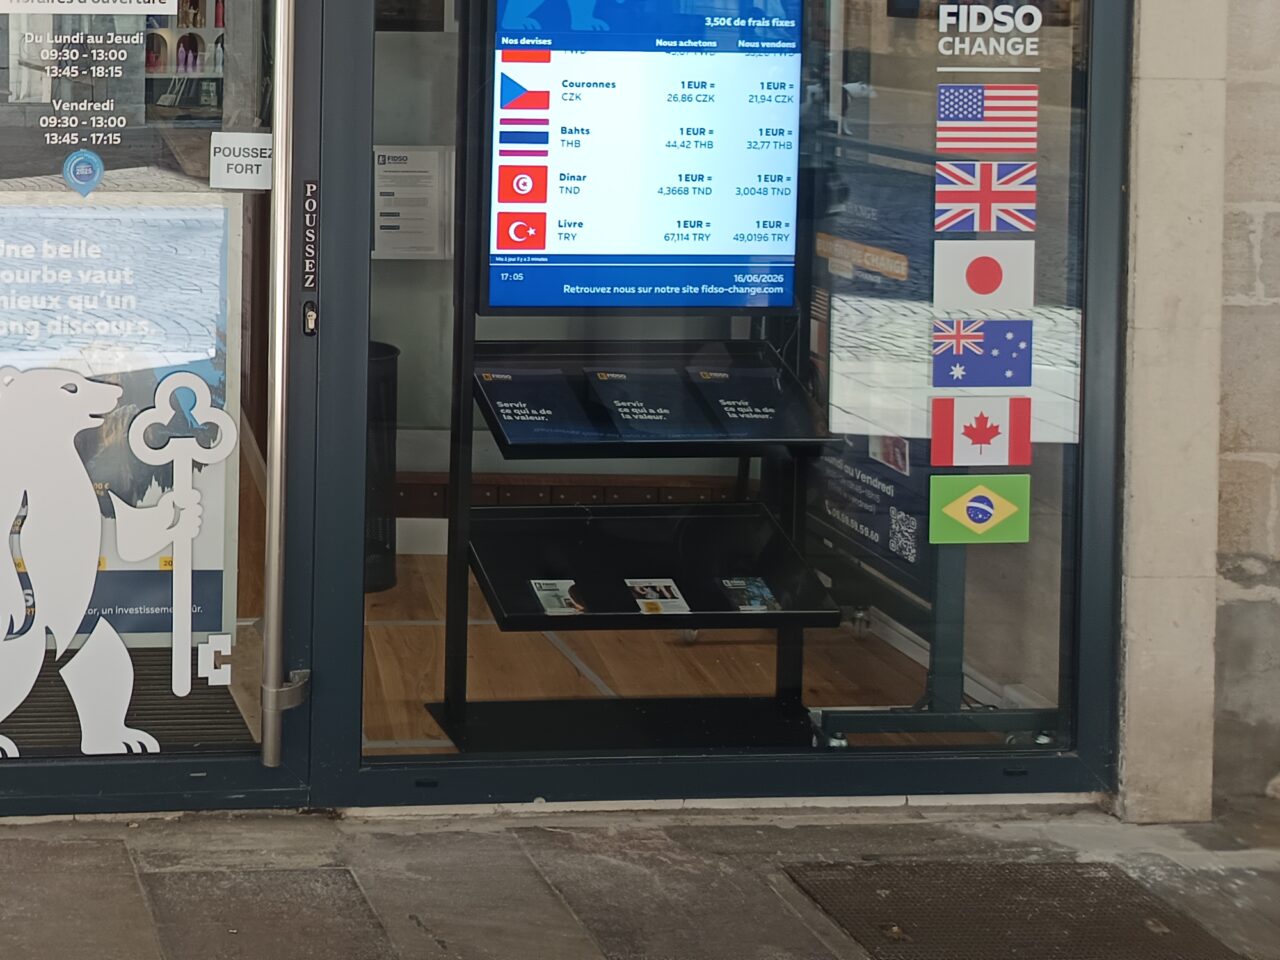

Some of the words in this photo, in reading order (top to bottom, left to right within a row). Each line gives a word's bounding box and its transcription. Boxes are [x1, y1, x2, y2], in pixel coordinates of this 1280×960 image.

[734, 18, 746, 27] de
[748, 18, 770, 27] frais
[771, 18, 795, 27] fixes
[938, 4, 1043, 33] FIDSO
[24, 32, 42, 44] Du
[46, 32, 84, 44] Lundi
[86, 34, 104, 44] au
[106, 32, 144, 44] Jeudi
[501, 37, 518, 45] Nos
[520, 37, 552, 45] devises
[655, 39, 677, 47] Nous
[679, 39, 717, 48] achetons
[738, 40, 760, 48] Nous
[761, 40, 796, 49] vendons
[937, 36, 1040, 56] CHANGE
[40, 49, 79, 60] 09:30
[90, 49, 127, 61] 13:00
[44, 66, 79, 77] 13:45
[90, 66, 122, 77] 18:15
[561, 80, 616, 88] Couronnes
[687, 81, 707, 89] EUR
[561, 92, 582, 101] CZK
[695, 94, 715, 103] CZK
[774, 95, 794, 103] CZK
[52, 99, 114, 111] Vendredi
[40, 116, 79, 128] 09:30
[90, 116, 126, 128] 13:00
[560, 126, 590, 135] Bahts
[686, 128, 706, 136] EUR
[44, 133, 79, 144] 13:45
[90, 133, 121, 145] 17:15
[560, 140, 581, 148] THB
[694, 141, 714, 149] THB
[773, 141, 793, 149] THB
[227, 163, 262, 174] FORT
[559, 173, 587, 181] Dinar
[685, 174, 705, 182] EUR
[559, 186, 580, 194] TND
[692, 187, 712, 195] TND
[771, 188, 791, 196] TND
[558, 220, 584, 228] Livre
[304, 183, 317, 288] POUSSEZ
[692, 233, 711, 241] TRY
[771, 233, 790, 241] TRY
[42, 239, 102, 259] belle
[78, 267, 134, 285] vaut
[734, 274, 784, 283] 16/06/2026
[563, 285, 611, 294] Retrouvez
[613, 286, 636, 294] nous
[637, 286, 651, 294] sur
[654, 285, 681, 294] notre
[682, 285, 699, 294] site
[701, 285, 783, 296] fidso-change.com
[854, 468, 894, 497] Vendredi
[101, 607, 113, 615] un
[115, 604, 173, 614] investisseme
